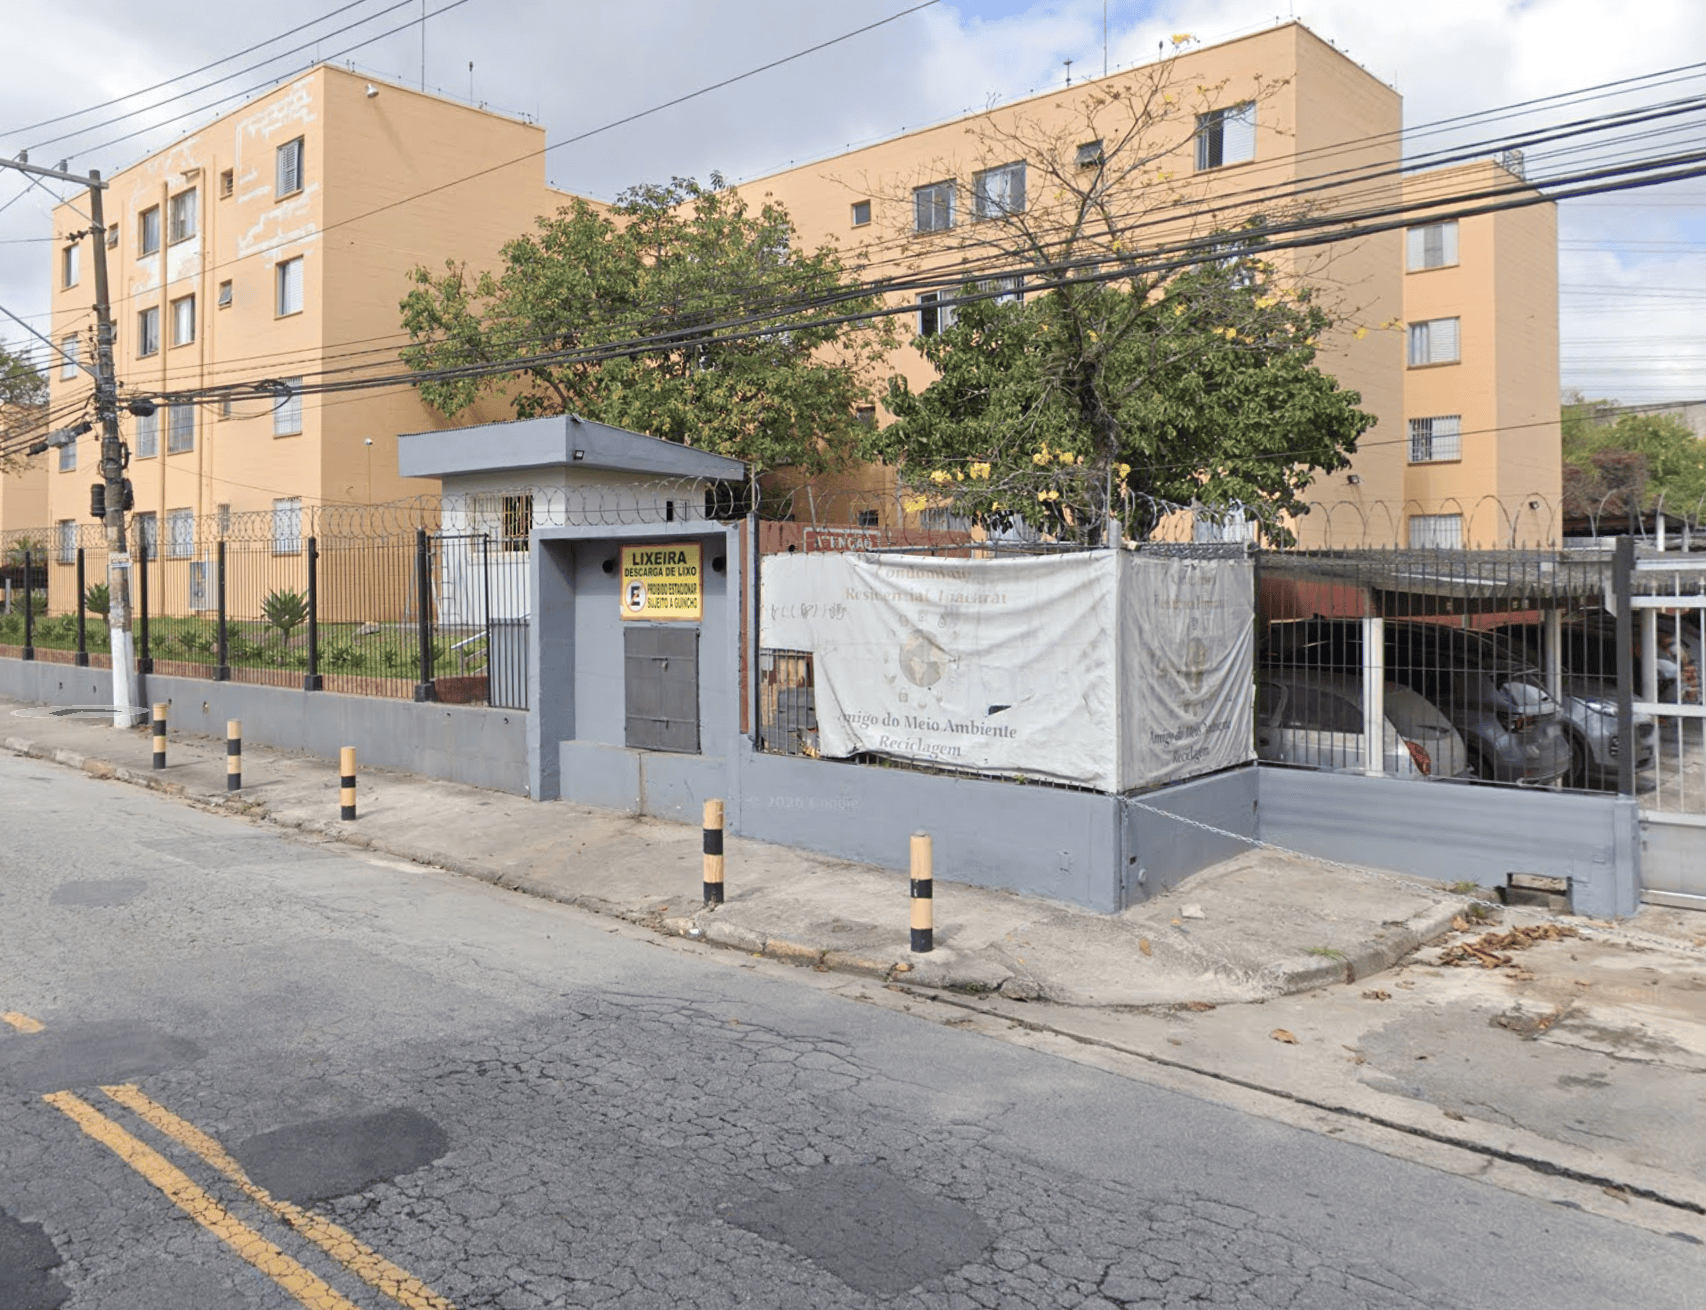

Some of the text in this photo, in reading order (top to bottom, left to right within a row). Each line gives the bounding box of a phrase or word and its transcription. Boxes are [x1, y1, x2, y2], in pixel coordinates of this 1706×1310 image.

[632, 550, 687, 566] LIXEIRA
[624, 566, 697, 577] DESCARGA DE LIXO
[647, 583, 697, 595] PROIBIDO ESTACIONAR
[647, 597, 668, 609] SUJEITO
[674, 597, 698, 609] GUINCHO
[836, 710, 1017, 739] migo do Meio Ambiente
[879, 735, 961, 758] Reciclagem
